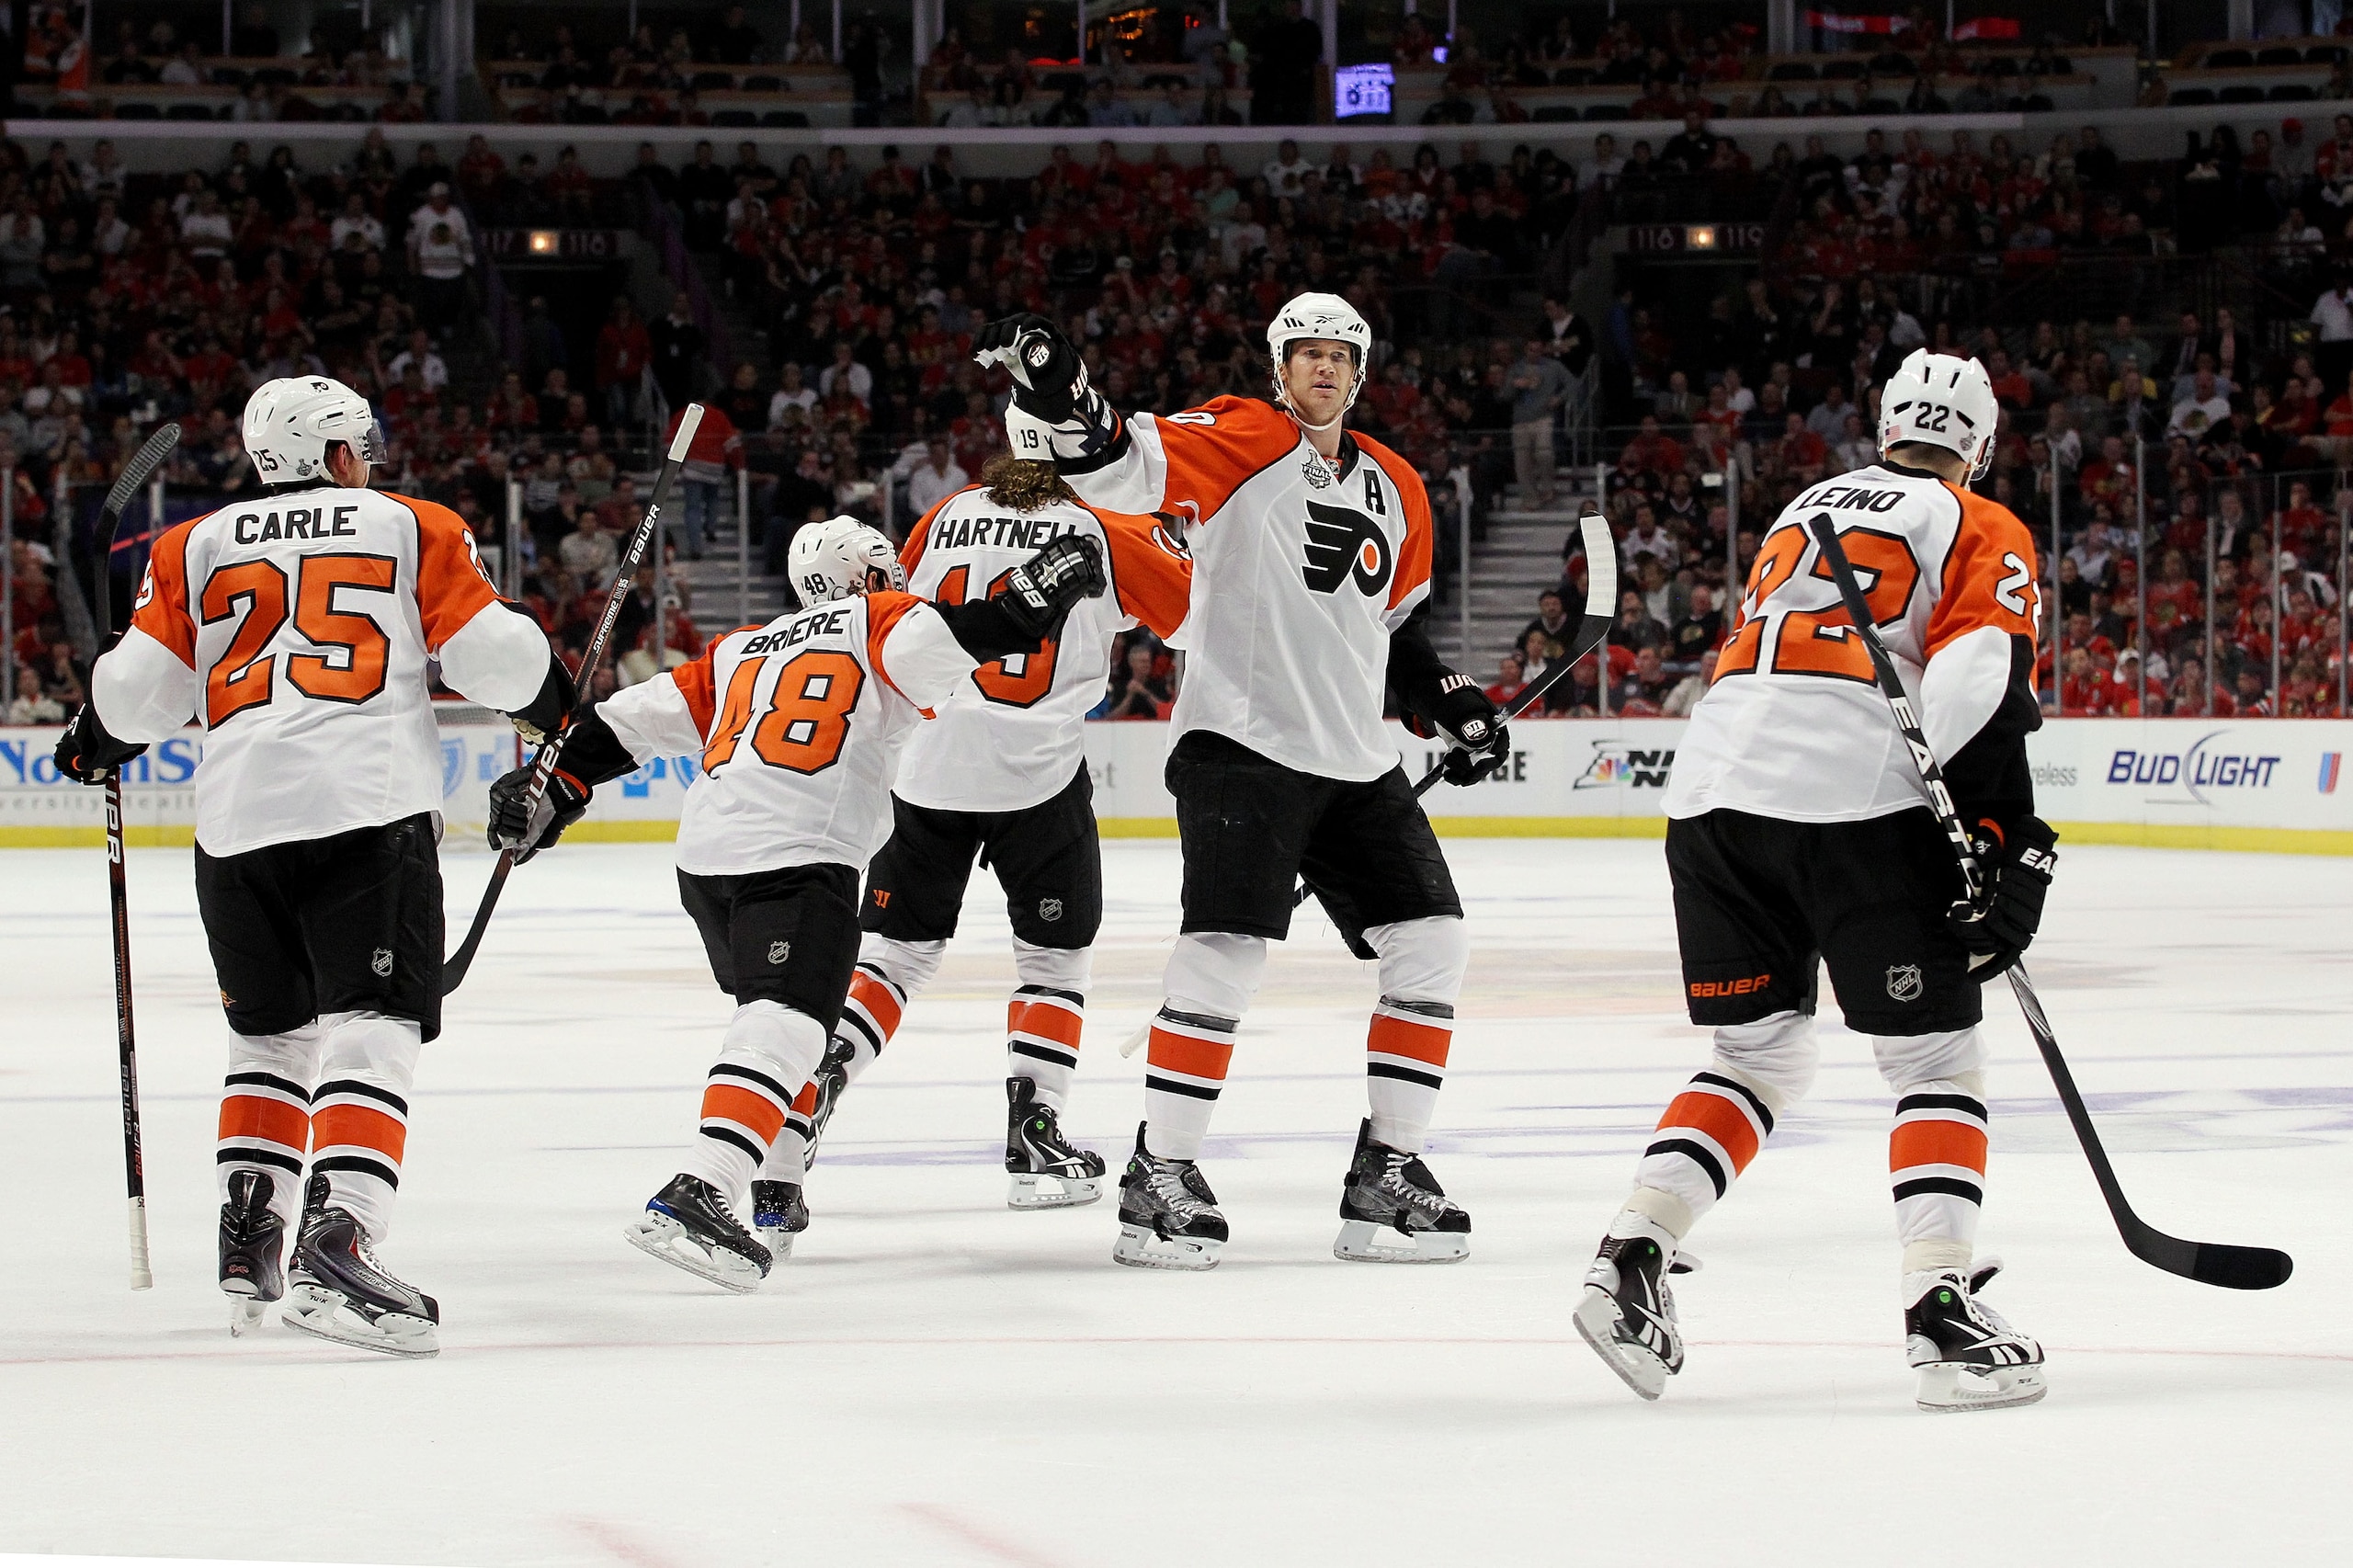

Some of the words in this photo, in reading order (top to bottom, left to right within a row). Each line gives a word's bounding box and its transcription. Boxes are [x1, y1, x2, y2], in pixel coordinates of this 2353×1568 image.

[1915, 401, 1949, 433] 22
[1020, 428, 1040, 449] 19
[252, 448, 279, 472] 25
[1363, 469, 1386, 516] A
[1793, 486, 1907, 514] LEINO
[234, 506, 358, 545] CARLE
[802, 573, 828, 597] 48
[1710, 522, 1921, 688] 22
[200, 551, 398, 733] 25
[739, 608, 853, 655] BRIERE
[701, 647, 867, 780] 48
